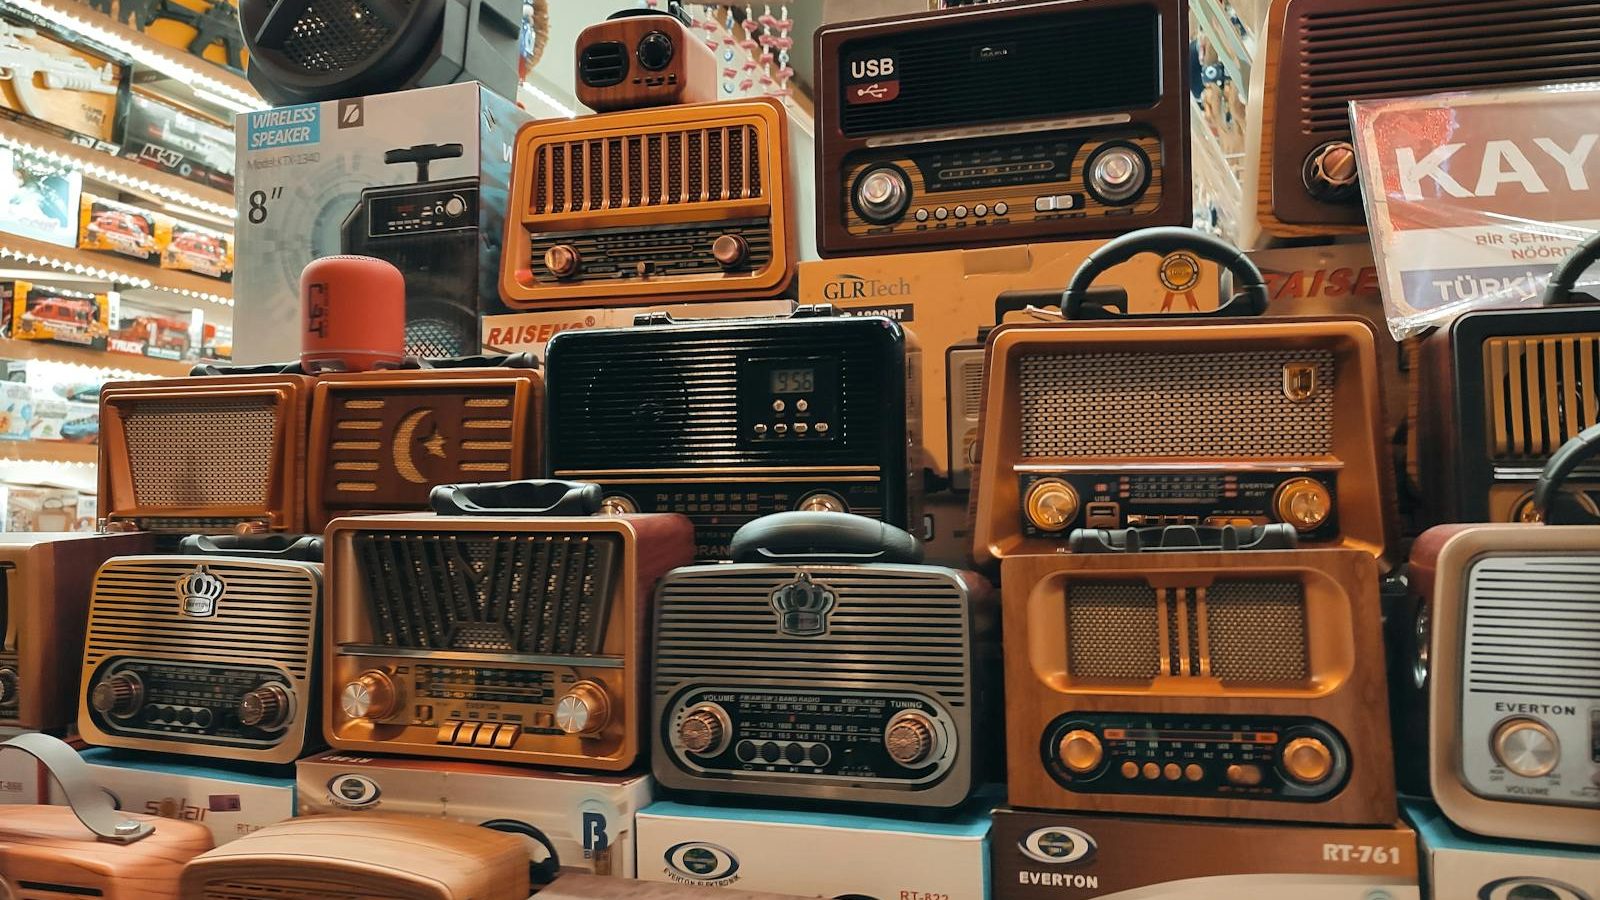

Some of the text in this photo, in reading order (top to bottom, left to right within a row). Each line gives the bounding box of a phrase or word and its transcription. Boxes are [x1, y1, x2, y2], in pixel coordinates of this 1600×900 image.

[851, 57, 894, 78] USB
[252, 107, 316, 129] WIRELESS
[250, 126, 310, 148] SPEAKER
[823, 277, 911, 300] GLRTech
[890, 700, 923, 709] TUNING
[1495, 702, 1577, 715] EVERTON
[1505, 785, 1549, 795] VOLUME
[1323, 844, 1400, 864] RT-761
[1019, 871, 1098, 888] EVERTON
